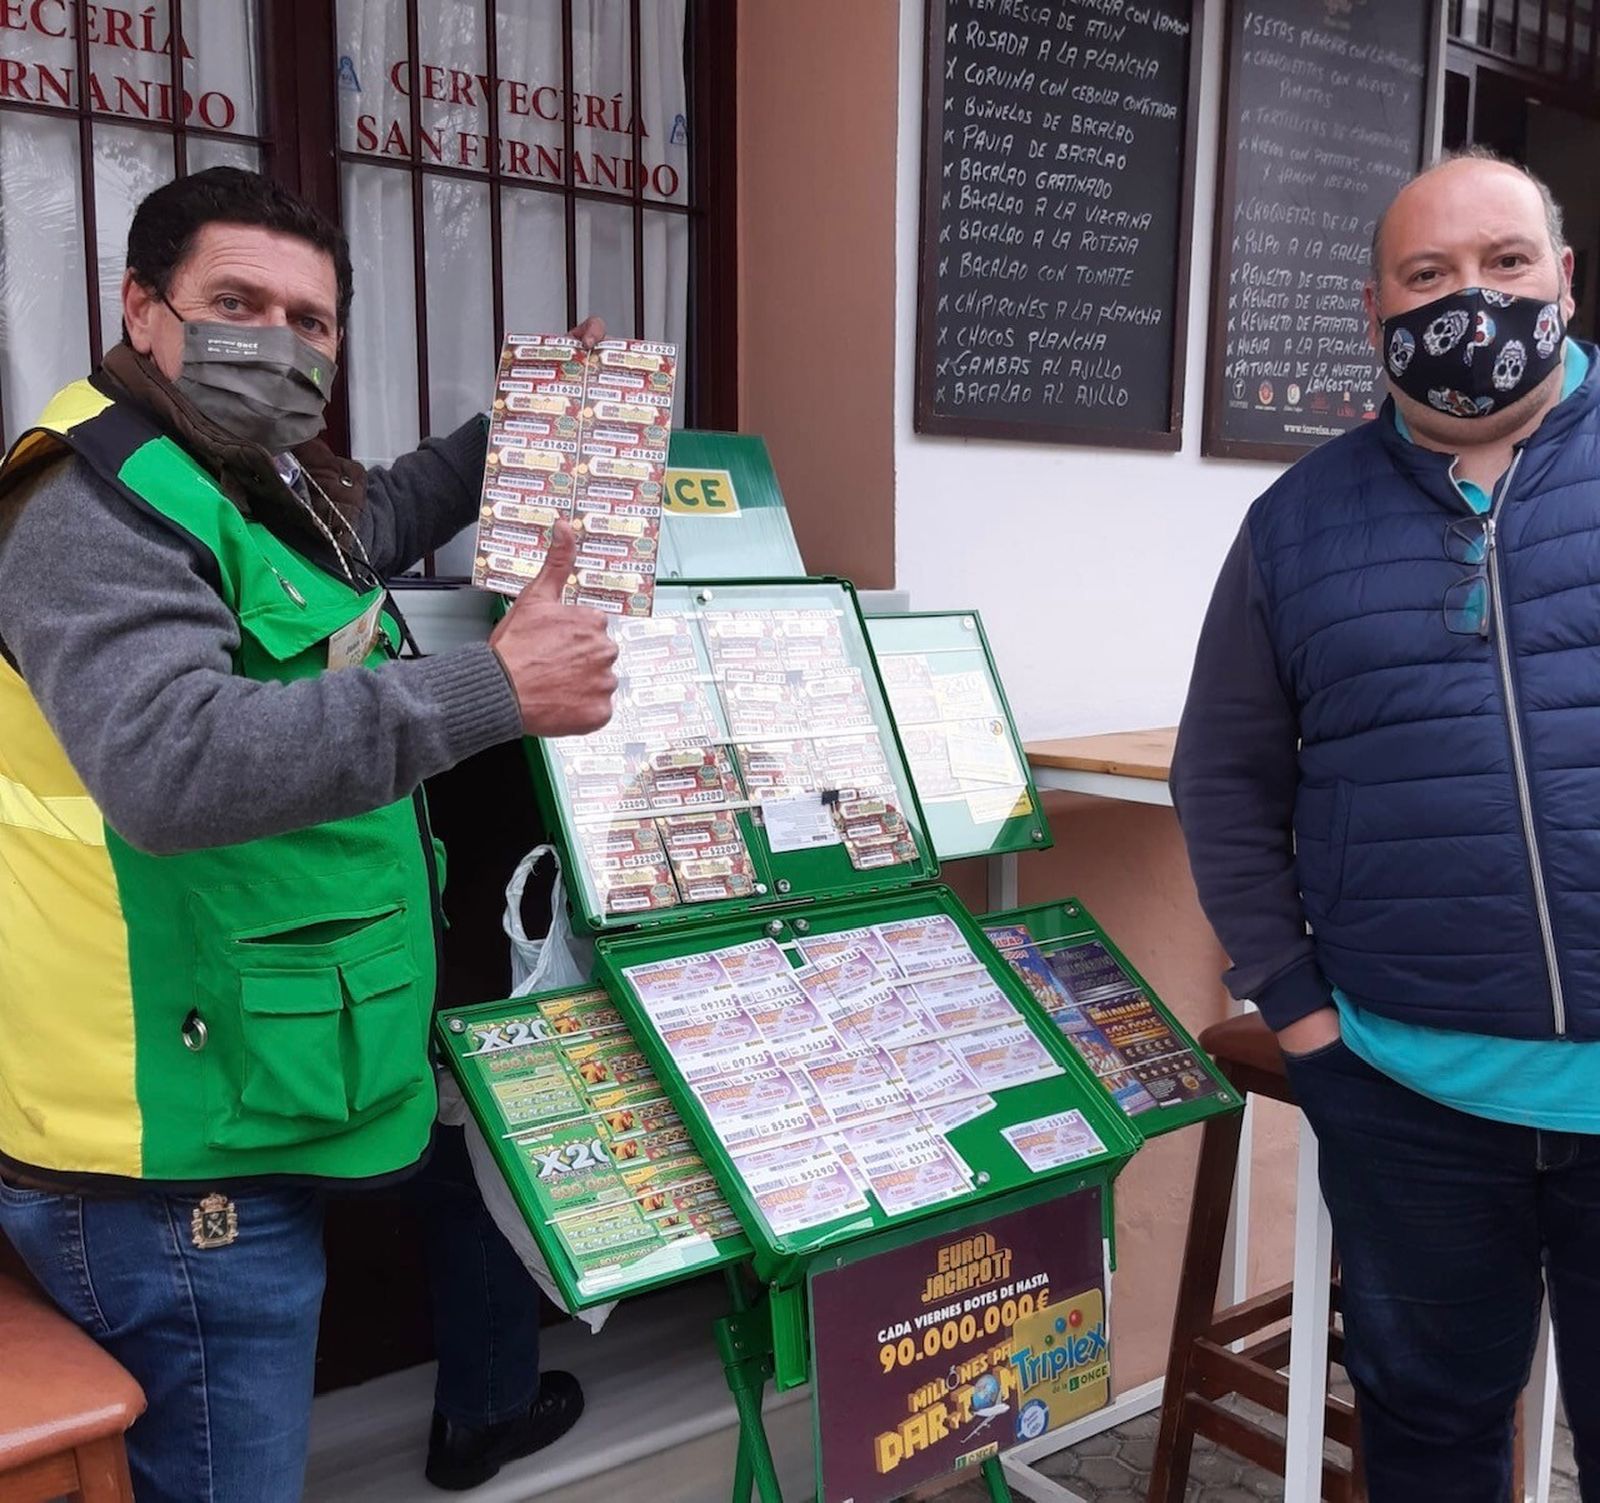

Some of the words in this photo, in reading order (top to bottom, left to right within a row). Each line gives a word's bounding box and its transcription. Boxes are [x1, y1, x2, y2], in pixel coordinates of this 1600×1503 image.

[1057, 12, 1076, 31] DE
[1124, 6, 1150, 24] CON
[966, 21, 1029, 56] ROSADA
[1037, 40, 1051, 61] A
[1057, 41, 1078, 69] LA
[1083, 48, 1159, 79] PLANCHA
[390, 61, 650, 137] CERVECERÍA
[1040, 78, 1068, 98] CON
[1071, 85, 1119, 106] CEBOLLA
[964, 96, 1032, 124] BUÑUELOS
[1043, 112, 1060, 132] DE
[1071, 114, 1134, 144] BACALAO
[356, 114, 443, 162] SAN
[458, 132, 679, 197] FERNANDO
[1028, 139, 1046, 158] DE
[1055, 143, 1127, 170] BACALAO
[960, 157, 1026, 187] BACALAO
[1035, 171, 1112, 200] GRATINADO
[958, 184, 1024, 214] BACALAO
[1035, 197, 1047, 217] A
[1053, 202, 1077, 223] LA
[958, 219, 1025, 245] BACALAO
[1032, 229, 1045, 247] A
[1051, 230, 1071, 251] LA
[1079, 230, 1140, 254] ROTEÑA
[1322, 212, 1339, 230] DE
[1341, 216, 1358, 233] LA
[1288, 237, 1299, 256] A
[1304, 238, 1323, 259] LA
[959, 251, 1028, 281] BACALAO
[1038, 264, 1066, 282] CON
[1076, 265, 1135, 287] TOMATE
[1297, 271, 1313, 289] DE
[1316, 274, 1349, 291] SETAS
[954, 289, 1049, 321] CHIPIRONES
[1055, 301, 1068, 316] A
[1071, 299, 1093, 322] LA
[1099, 299, 1162, 326] PLANCHA
[1295, 294, 1312, 310] DE
[956, 324, 1015, 350] CHOCOS
[1028, 327, 1108, 353] PLANCHA
[1297, 315, 1311, 331] DE
[1312, 315, 1359, 334] PATATAS
[1284, 338, 1292, 355] A
[1297, 336, 1313, 356] LA
[952, 350, 1031, 378] GAMBAS
[1040, 355, 1060, 377] AL
[1068, 358, 1122, 381] AJILLO
[1295, 361, 1308, 380] DE
[1312, 362, 1326, 379] LA
[952, 380, 1032, 406] BACALAO
[1043, 382, 1064, 406] AL
[1075, 384, 1129, 407] AJILLO
[937, 1232, 995, 1273] EURO
[920, 1248, 1012, 1304] JACKPOT
[877, 1319, 913, 1344] CADA
[913, 1302, 962, 1329] VIERNES
[963, 1288, 998, 1313] BOTES
[999, 1283, 1015, 1300] DE
[1016, 1272, 1050, 1294] HASTA
[1010, 1321, 1108, 1391] Triplex
[908, 1353, 989, 1413] MILLONES
[1080, 1365, 1108, 1384] ONCE
[874, 1402, 950, 1475] DAR
